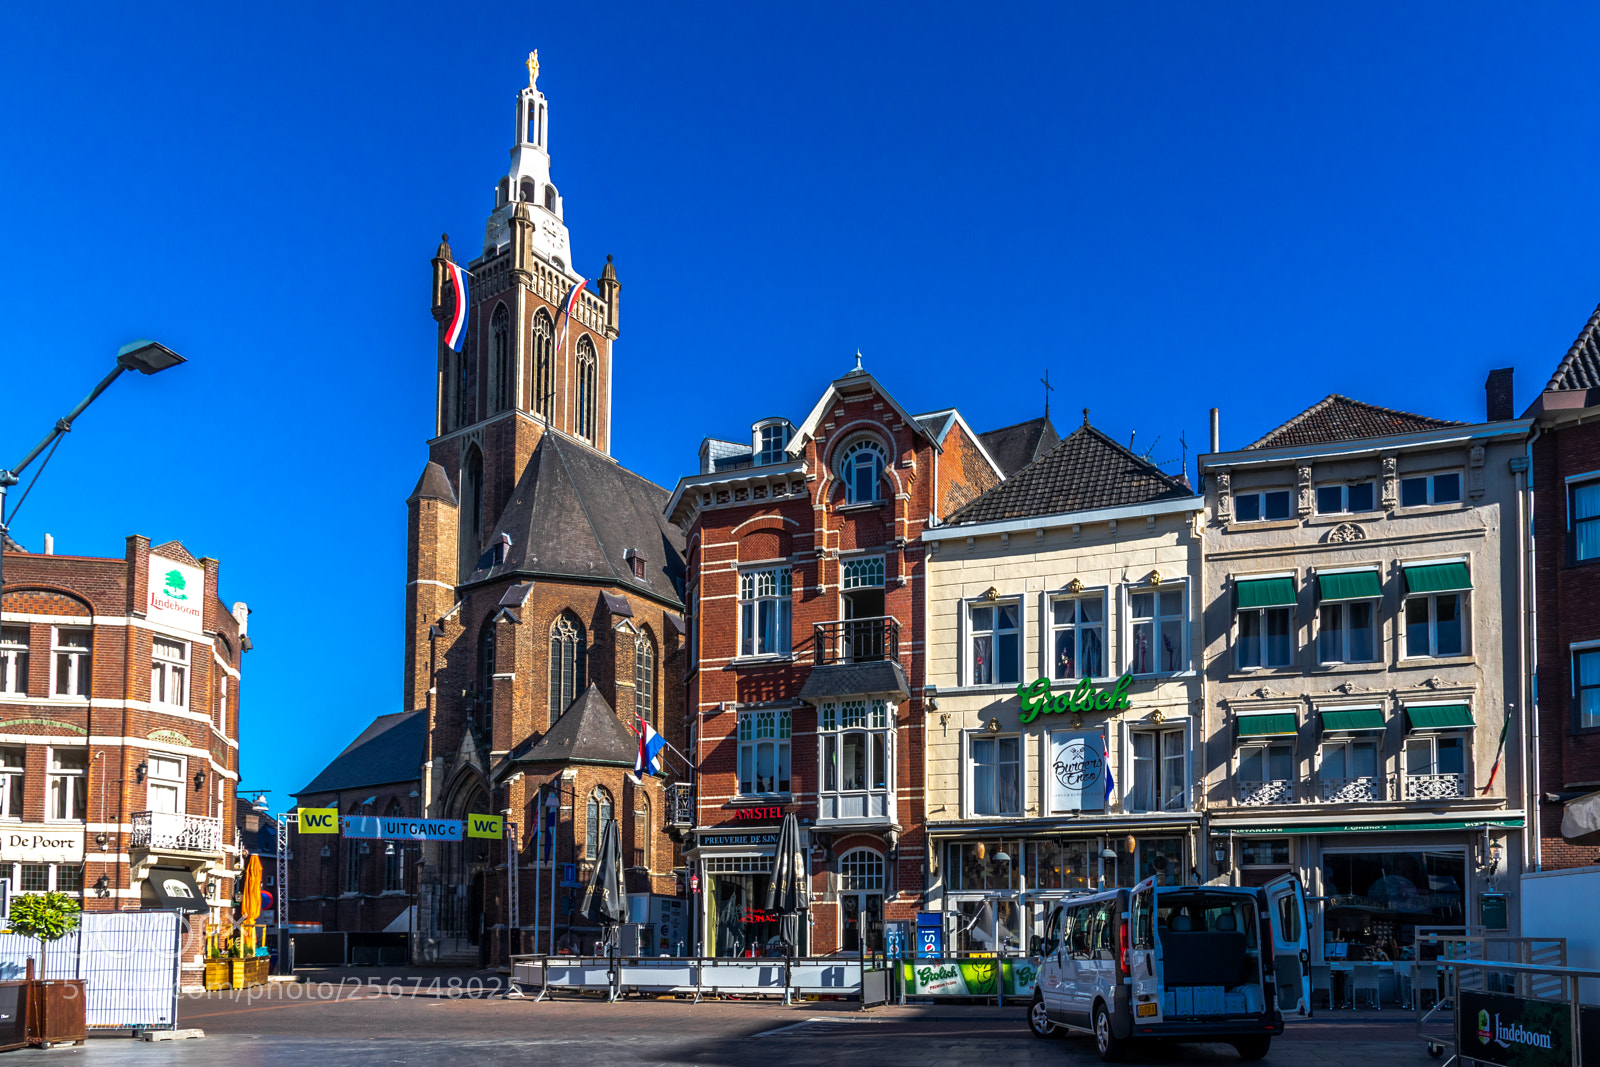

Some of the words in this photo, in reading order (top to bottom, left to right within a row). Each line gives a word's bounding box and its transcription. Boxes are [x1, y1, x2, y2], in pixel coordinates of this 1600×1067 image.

[150, 592, 200, 616] Lindeboom
[1016, 674, 1133, 723] Grolsch
[1053, 759, 1102, 775] Burgers
[1062, 770, 1096, 785] Enzo
[305, 814, 332, 827] WC
[734, 807, 784, 819] AMSTEL
[387, 822, 446, 835] UITGANG
[474, 820, 497, 833] WC
[9, 835, 29, 847] De
[29, 835, 75, 850] Poort
[704, 836, 747, 844] PREUVERIE
[750, 835, 760, 843] DE
[917, 966, 958, 986] Grolsch
[1494, 1013, 1552, 1049] Lindeboom
